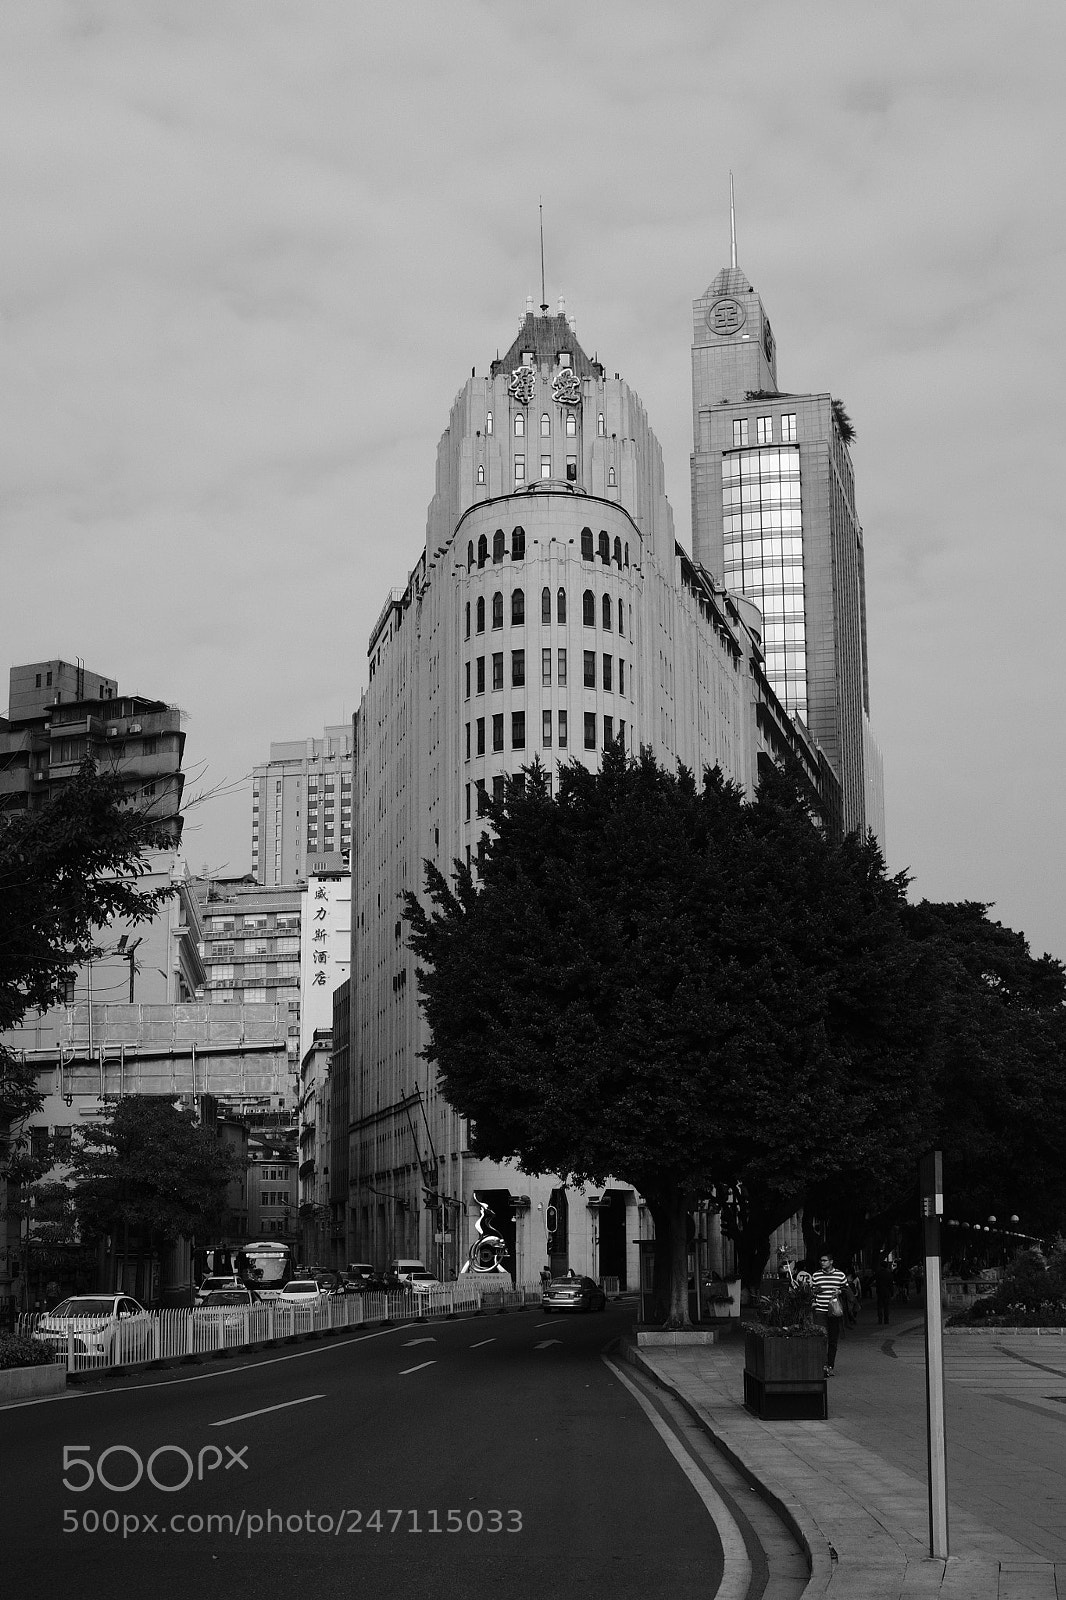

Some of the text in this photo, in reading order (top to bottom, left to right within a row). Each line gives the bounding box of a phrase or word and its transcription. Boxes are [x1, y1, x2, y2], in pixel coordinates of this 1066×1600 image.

[311, 886, 329, 986] 威力斯酒店
